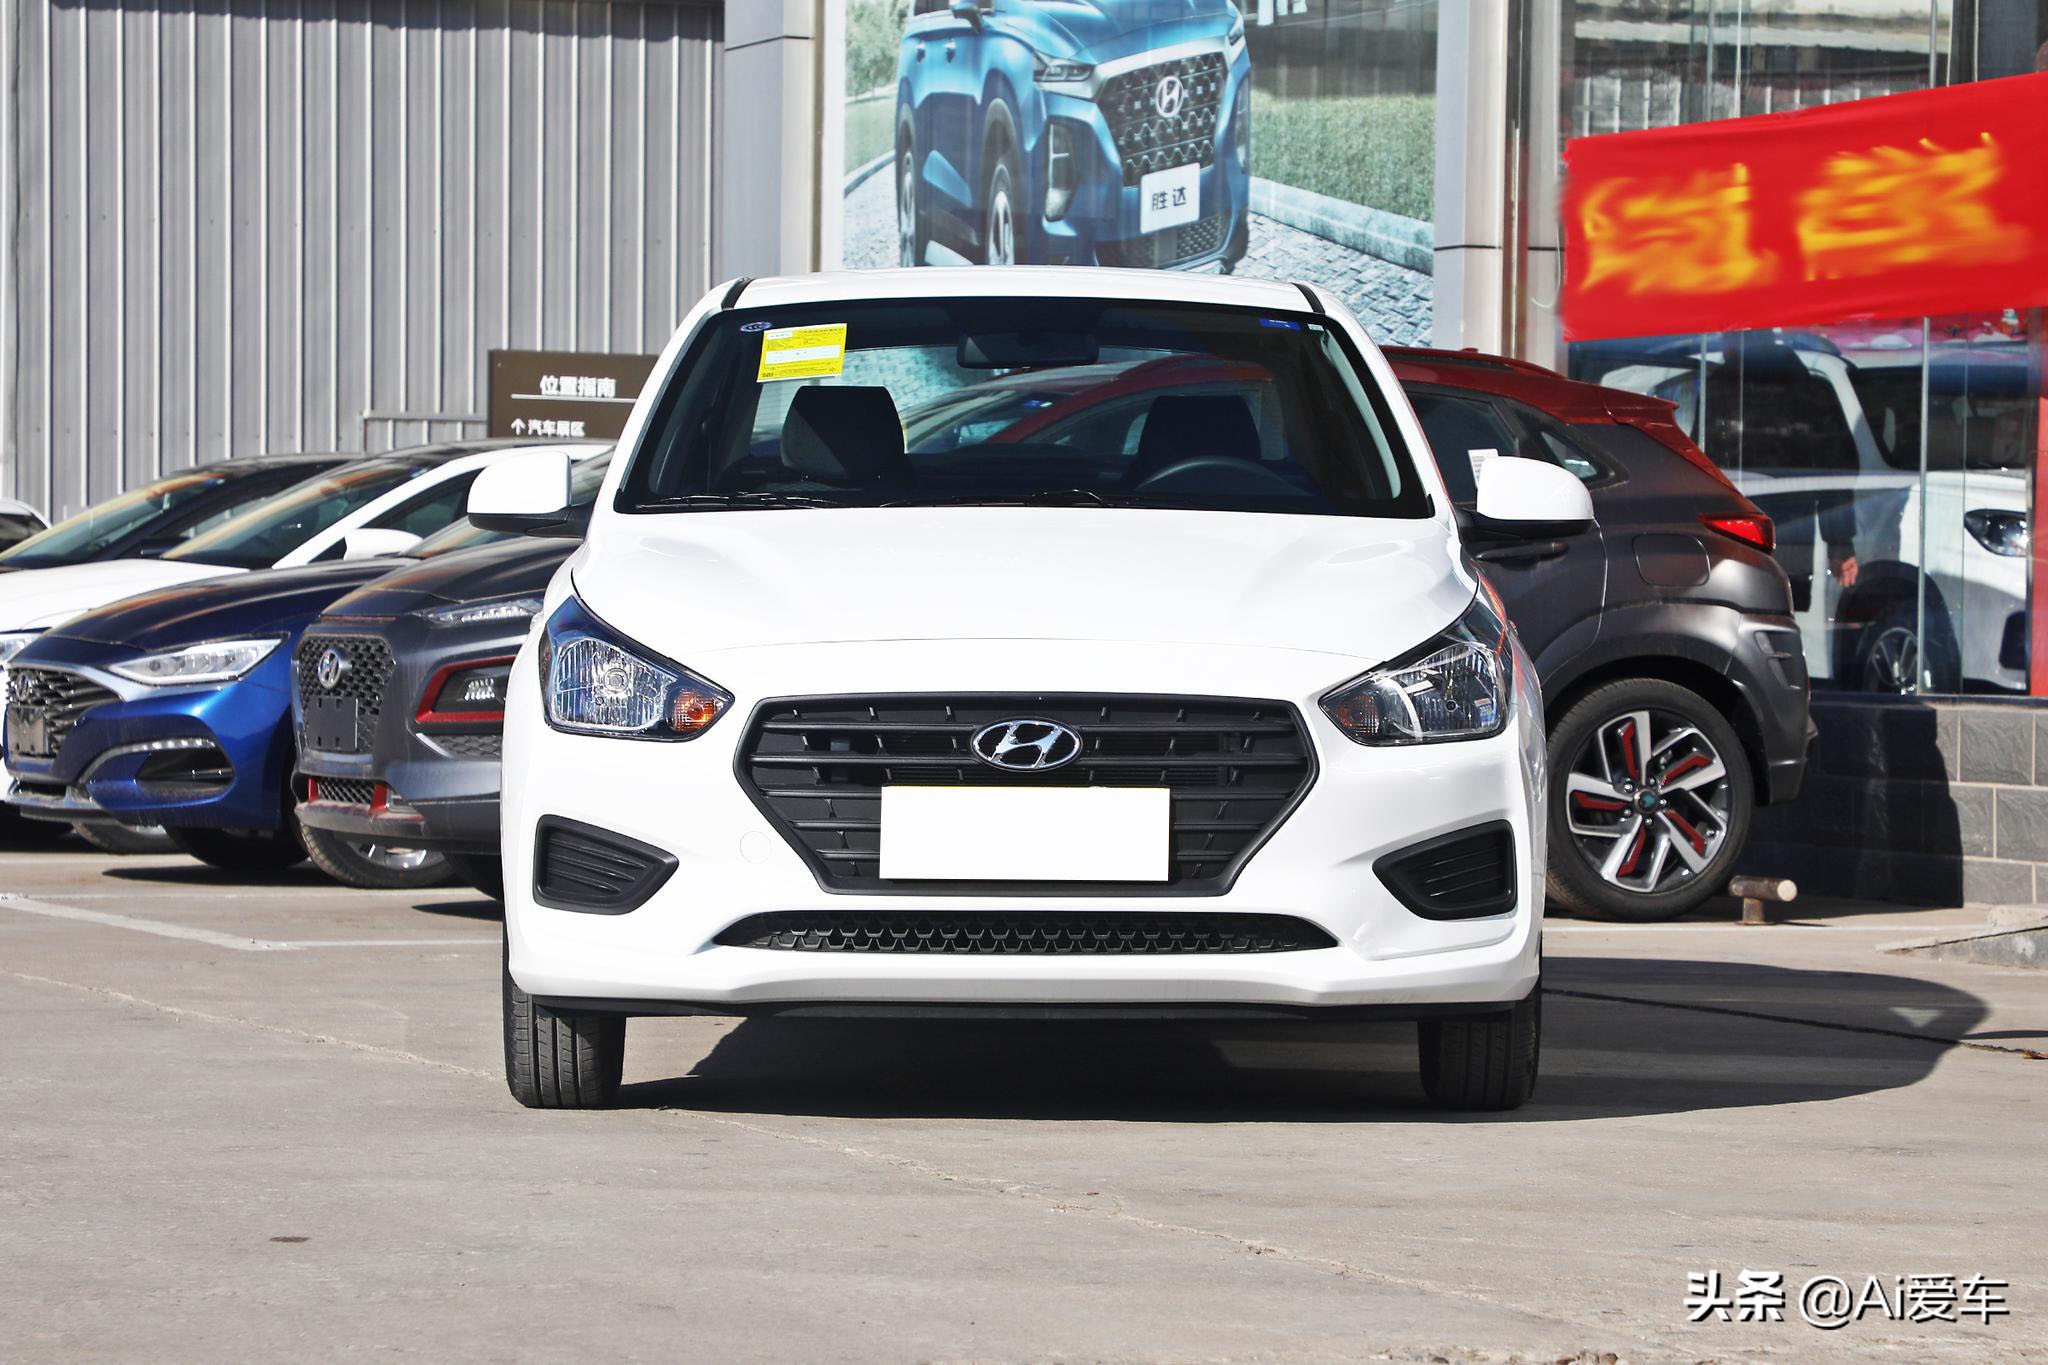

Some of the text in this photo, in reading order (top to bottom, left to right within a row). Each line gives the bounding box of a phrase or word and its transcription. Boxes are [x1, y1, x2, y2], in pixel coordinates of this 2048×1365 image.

[1152, 187, 1187, 211] 胜达
[540, 375, 616, 398] 位置指南
[528, 418, 585, 437] 汽车展区
